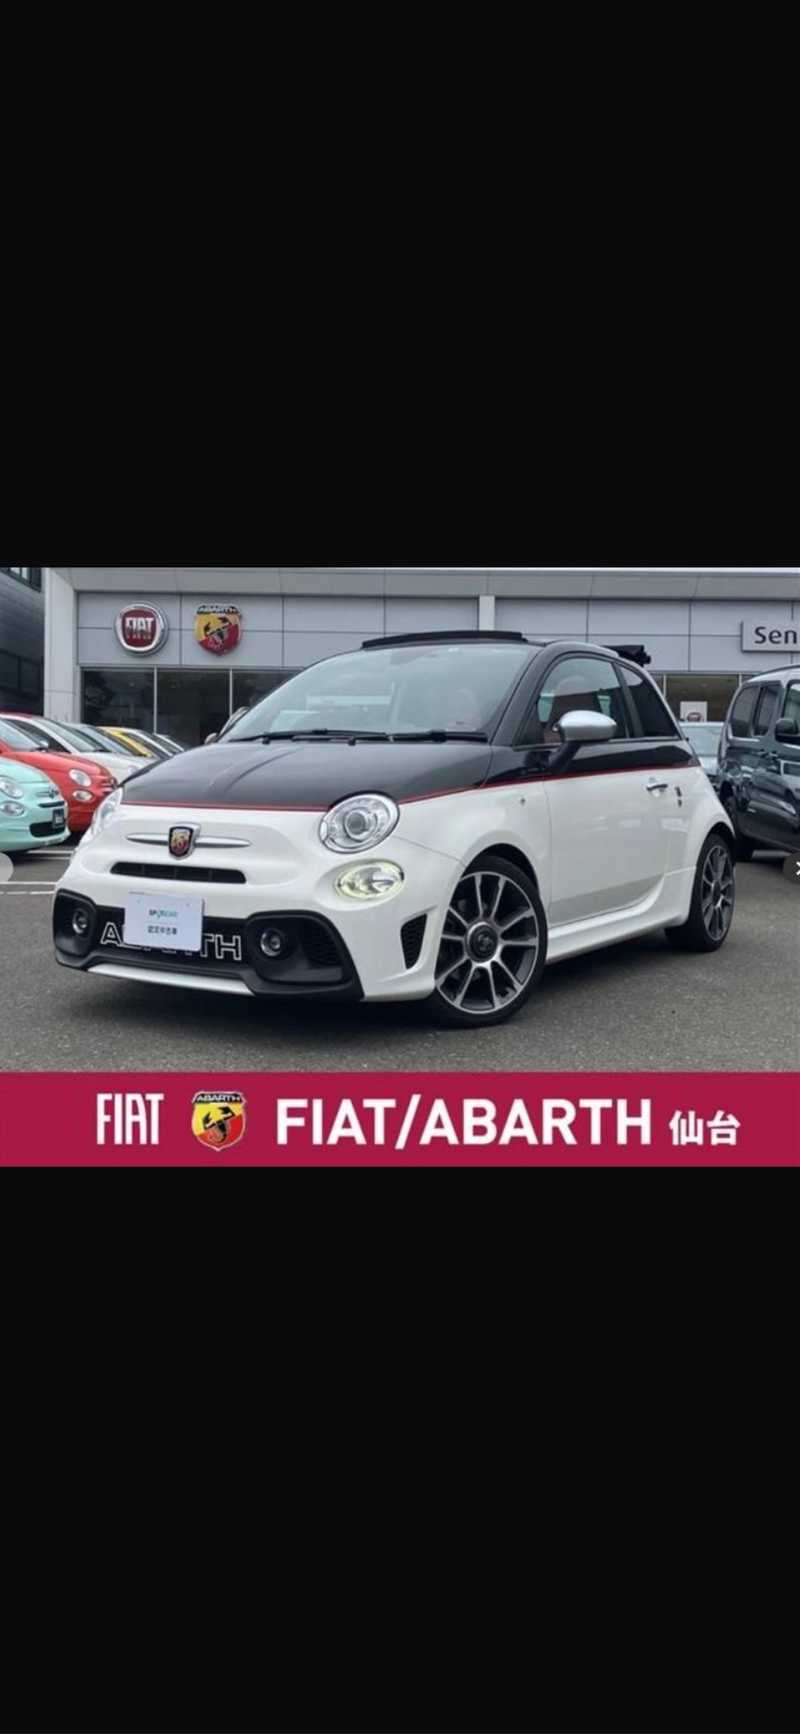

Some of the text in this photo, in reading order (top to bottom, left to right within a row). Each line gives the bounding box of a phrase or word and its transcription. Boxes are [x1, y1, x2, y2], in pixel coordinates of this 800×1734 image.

[125, 617, 154, 639] FIAT
[754, 626, 797, 644] Sen
[100, 921, 242, 961] ATH
